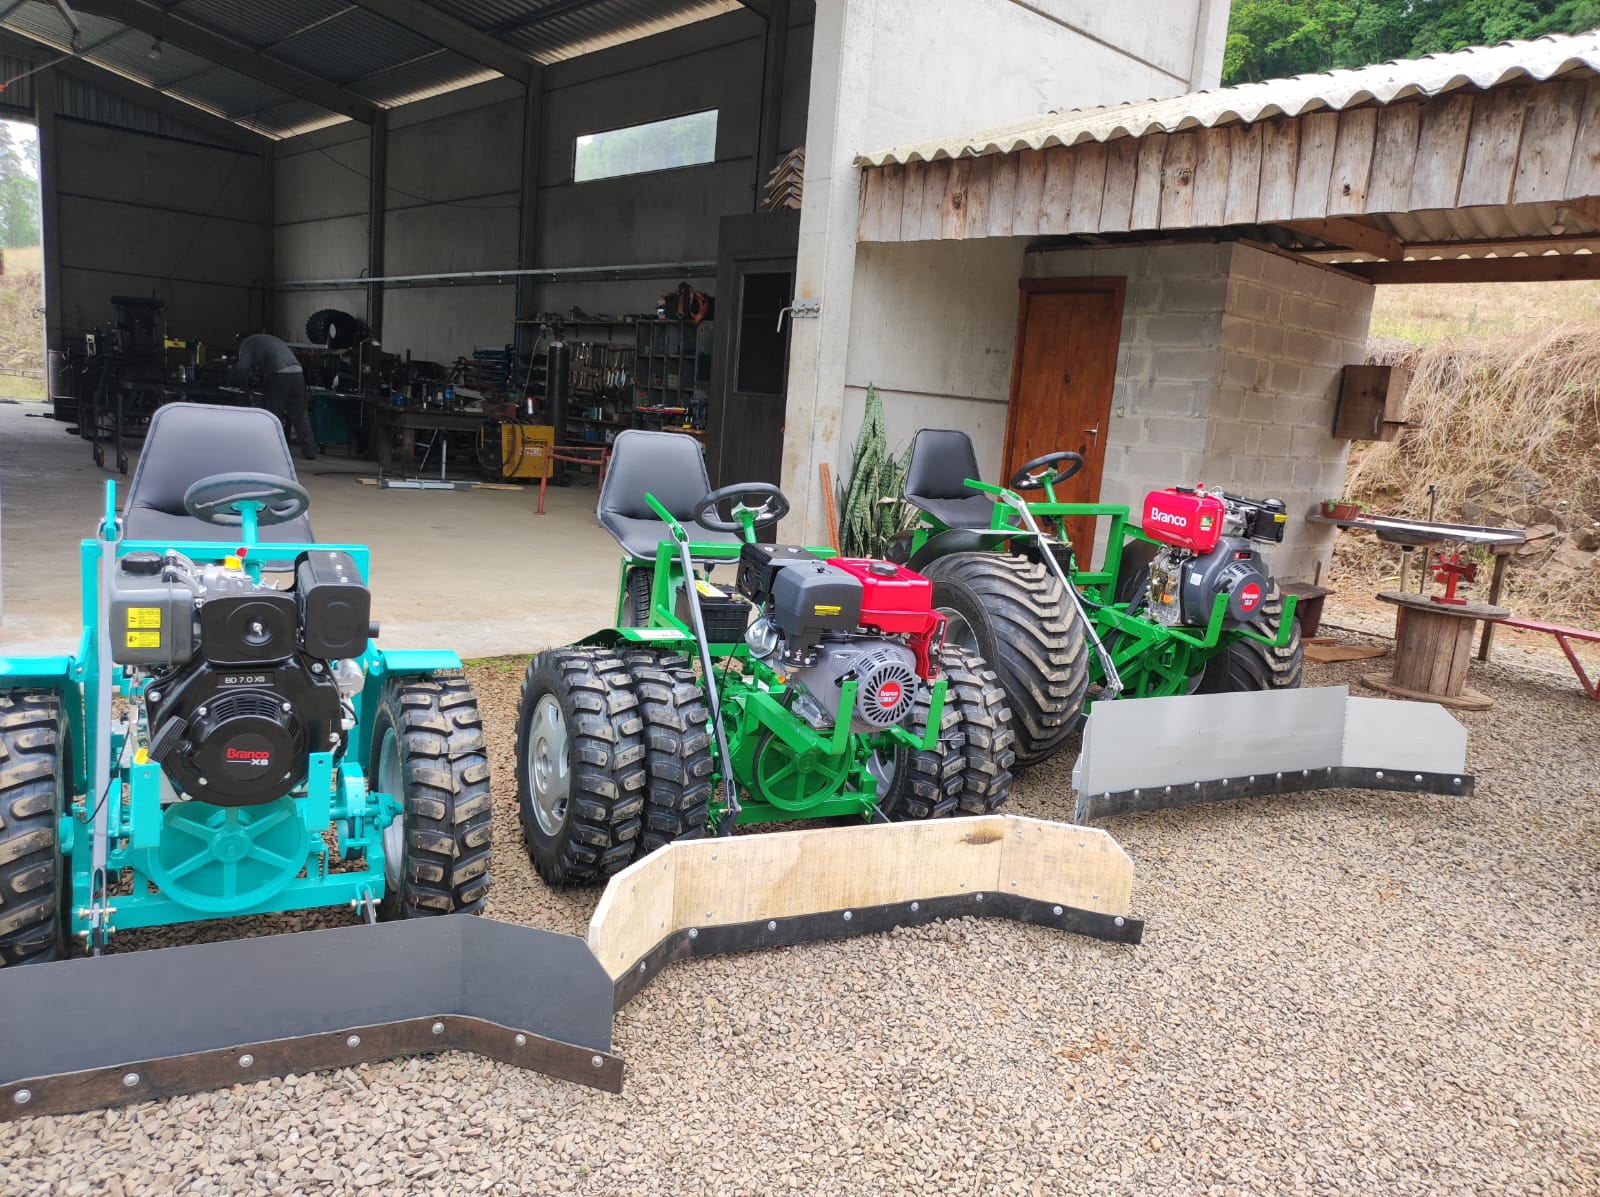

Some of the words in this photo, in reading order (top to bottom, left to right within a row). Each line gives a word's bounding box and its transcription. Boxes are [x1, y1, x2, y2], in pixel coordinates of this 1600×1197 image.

[1151, 507, 1187, 527] Branco
[239, 676, 253, 684] 7.0
[227, 748, 269, 759] Branco
